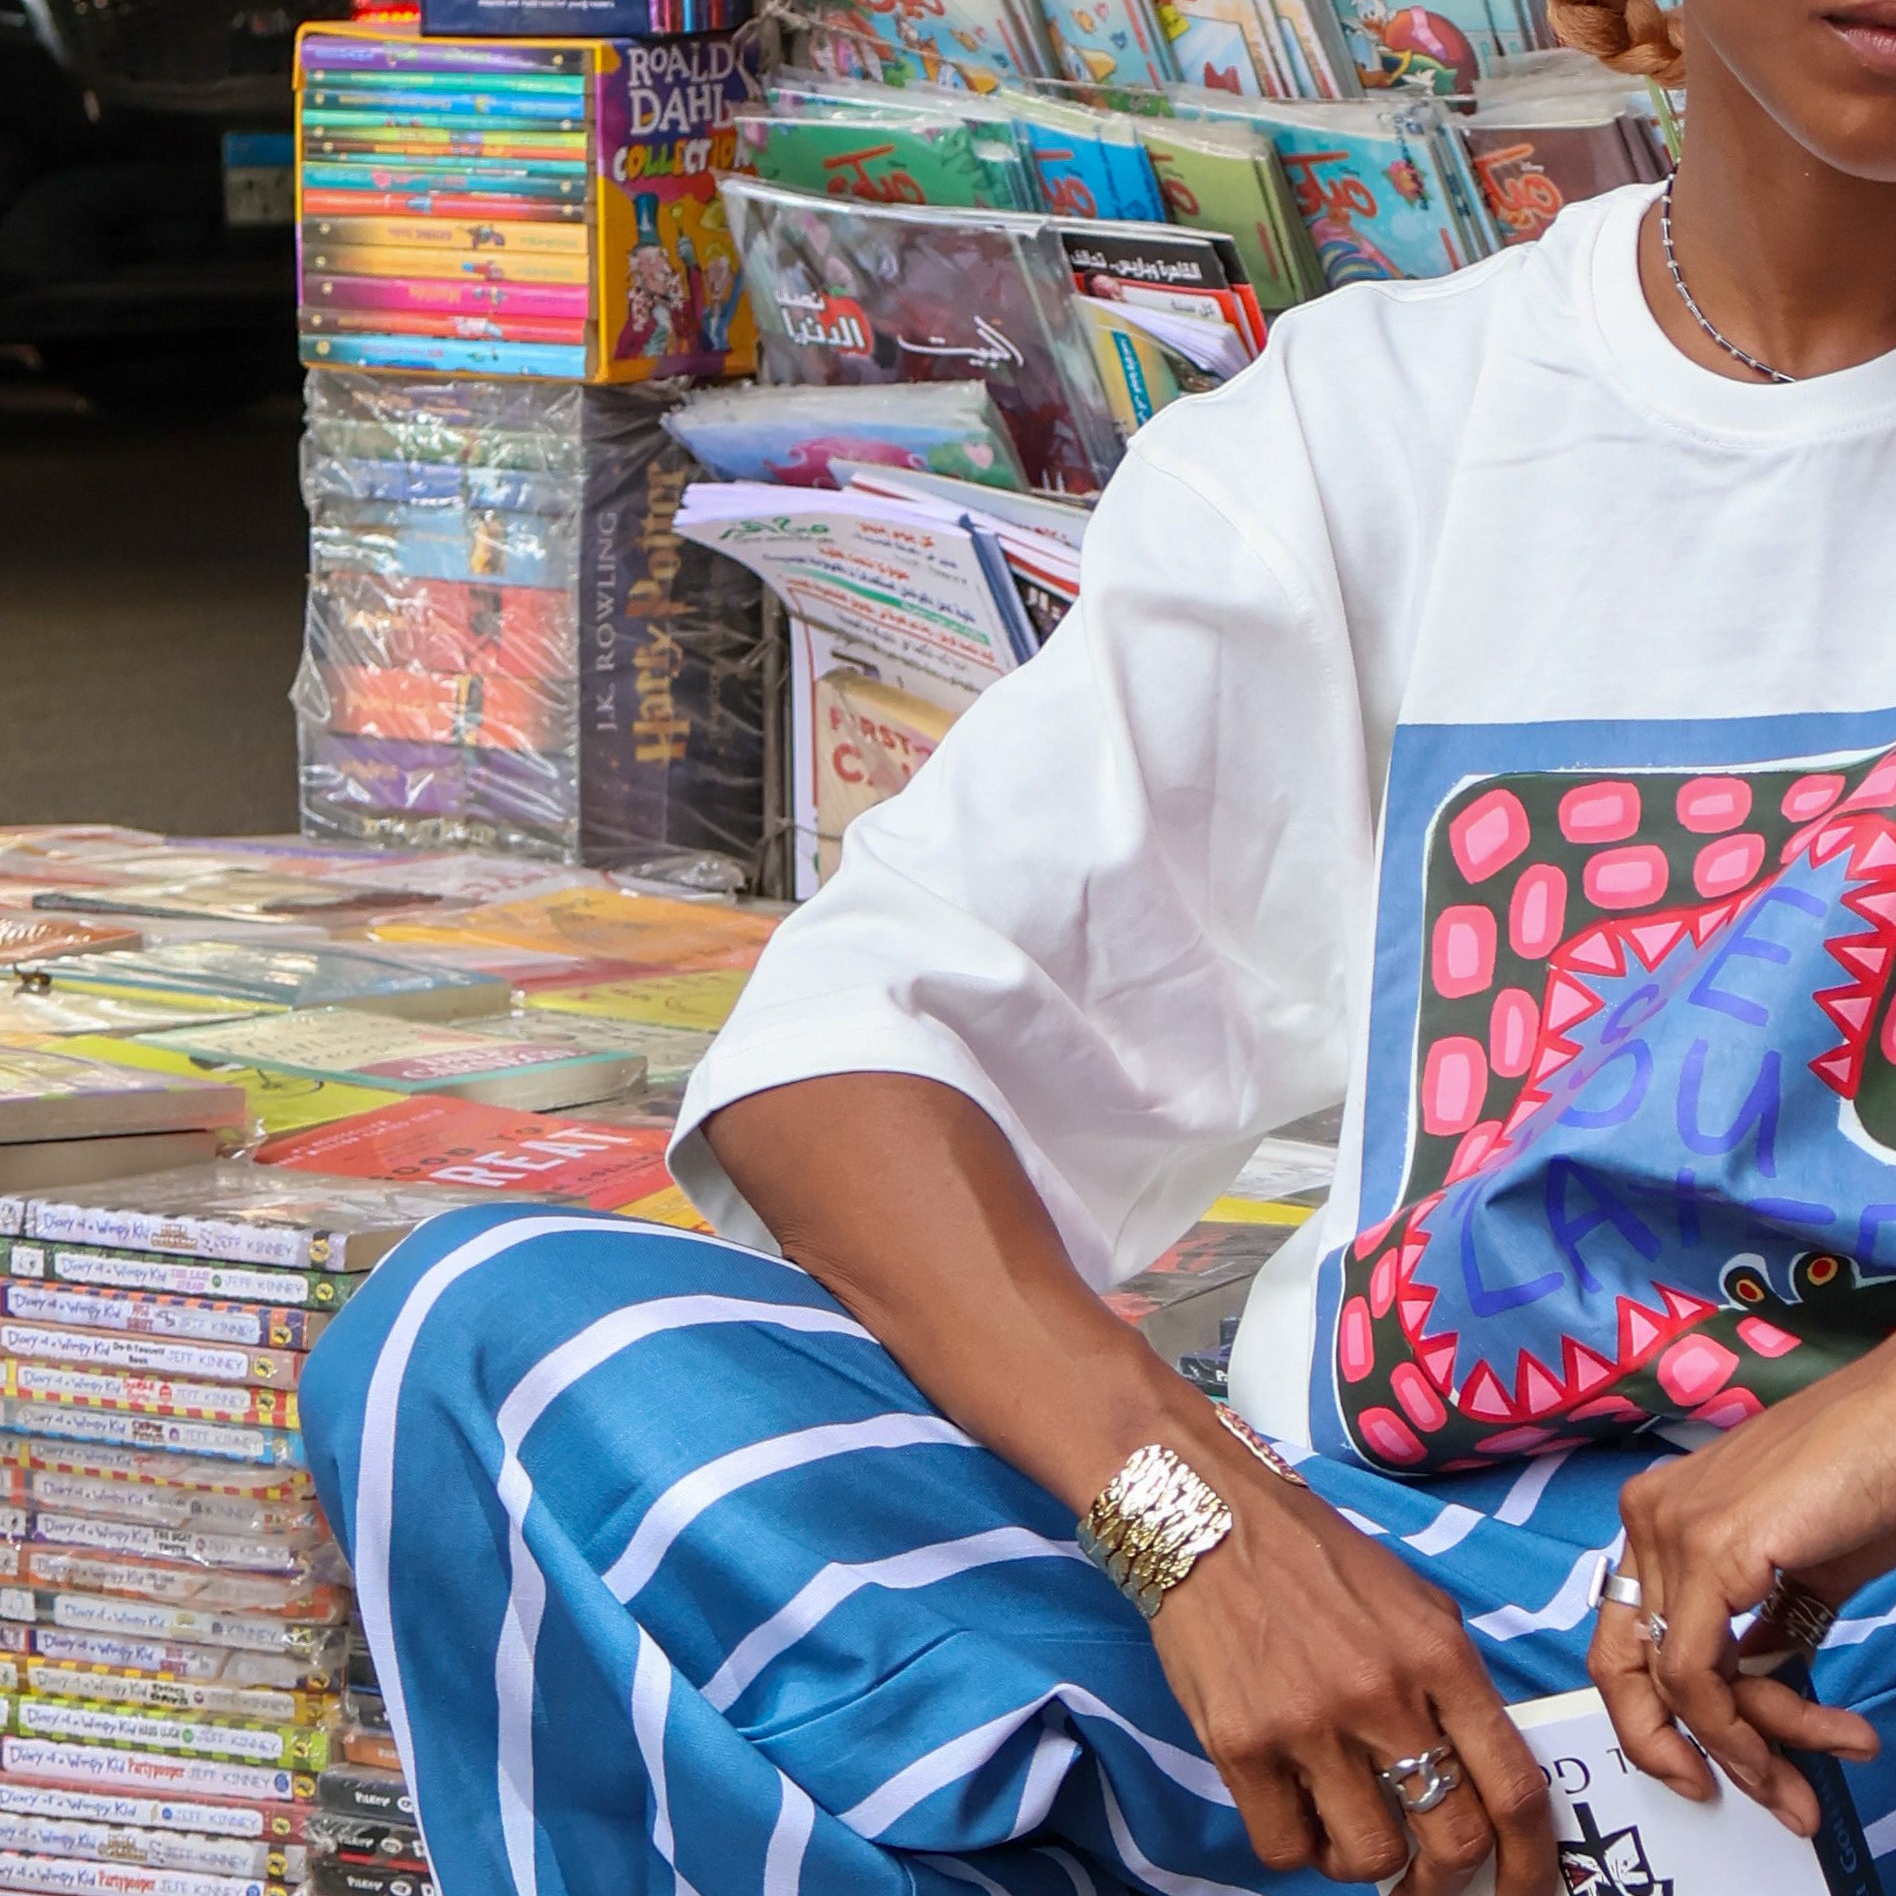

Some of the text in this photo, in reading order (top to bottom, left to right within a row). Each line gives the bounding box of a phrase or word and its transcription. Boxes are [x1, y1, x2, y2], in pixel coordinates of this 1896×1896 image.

[627, 41, 735, 88] ROALD
[628, 83, 736, 137] DAHL
[595, 509, 618, 666] ROWLING
[631, 623, 692, 765] Harry
[8, 1330, 38, 1349] Diary
[58, 1336, 92, 1357] Wimpy
[94, 1340, 110, 1357] Kid
[166, 1350, 194, 1365] JEFF
[199, 1353, 244, 1370] KINNEY
[10, 1744, 42, 1766] Diary
[67, 1750, 104, 1774] Wimpy
[107, 1753, 125, 1773] Kid
[222, 1772, 270, 1790] KINNEY
